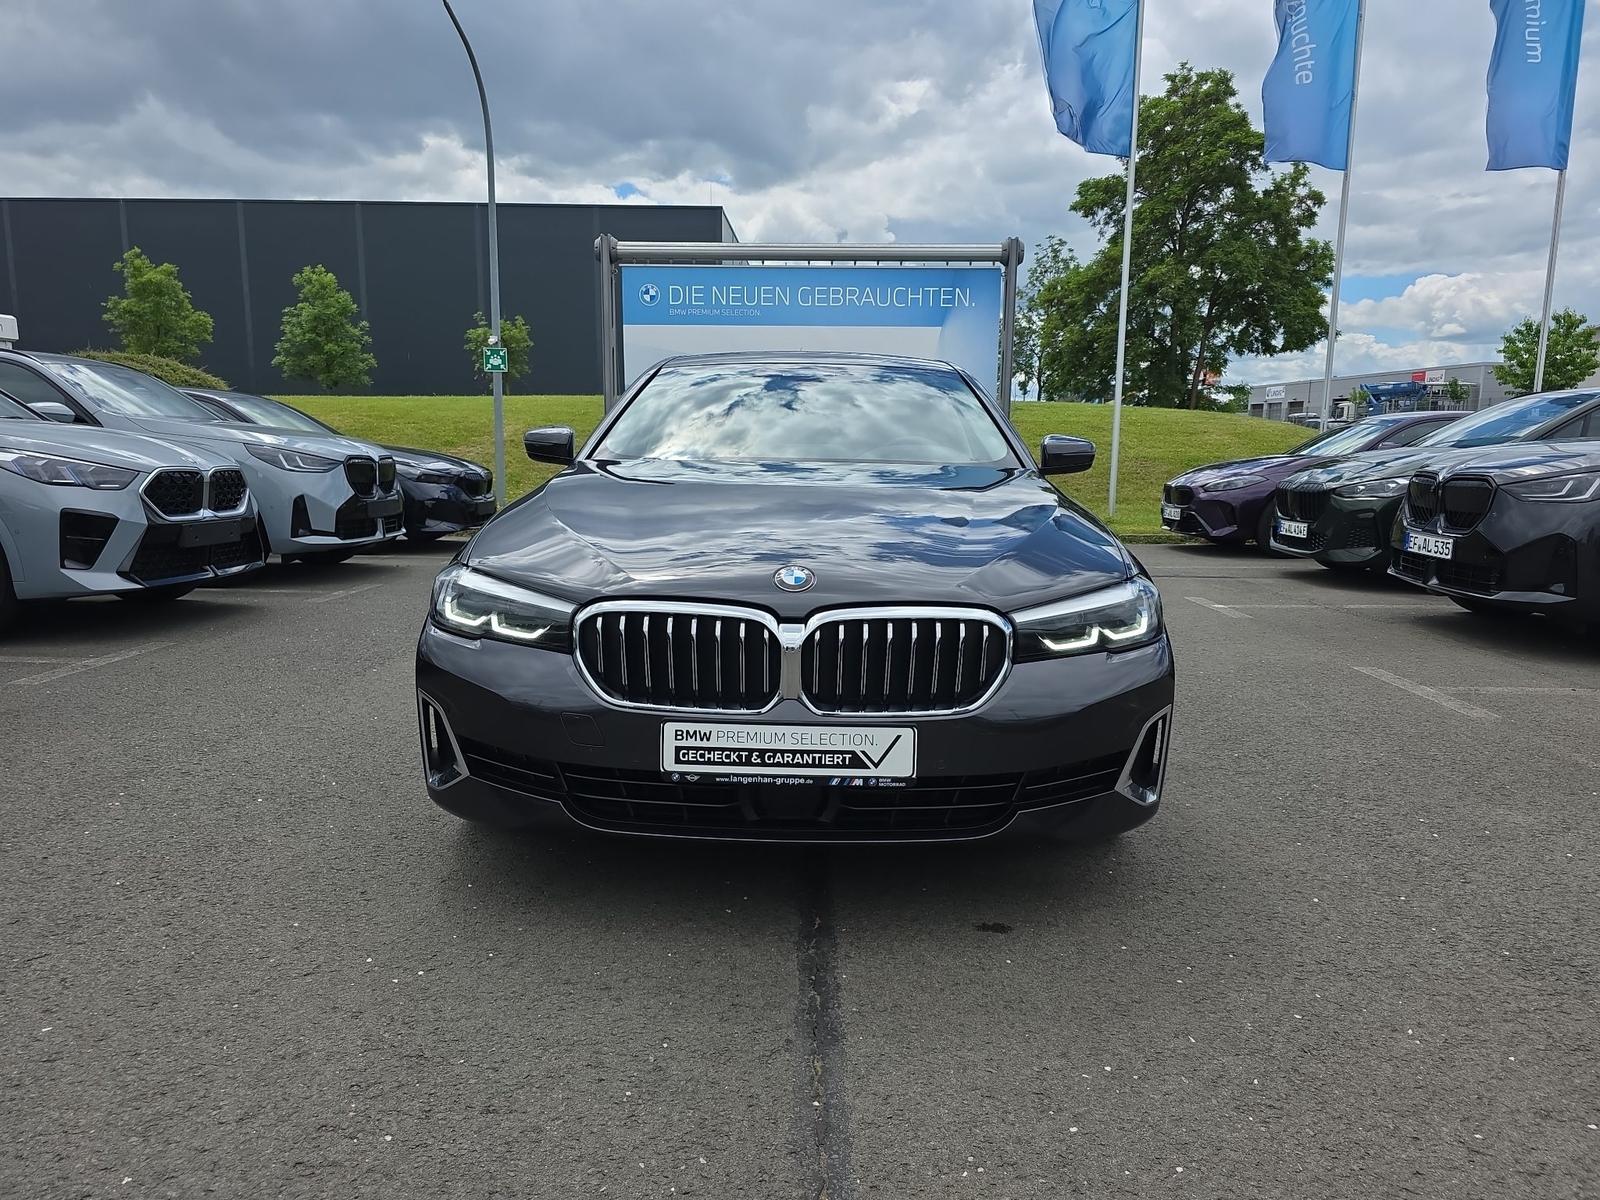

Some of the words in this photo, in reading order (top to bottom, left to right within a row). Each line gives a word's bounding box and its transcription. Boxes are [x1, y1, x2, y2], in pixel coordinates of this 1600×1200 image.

[669, 285, 705, 305] DIE
[712, 286, 790, 306] NEUEN
[797, 286, 976, 307] GEBRAUCHTEN.
[669, 308, 686, 316] BMW
[687, 308, 720, 316] PREMIUM
[1422, 538, 1432, 552] AL
[1433, 540, 1451, 556] 535
[674, 729, 712, 742] BMW
[716, 730, 786, 745] PREMIUM
[790, 732, 878, 746] SELECTION.
[679, 750, 749, 763] GECHECKT
[751, 752, 762, 763] &
[764, 752, 852, 765] GARANTIERT
[715, 774, 814, 785] www.langenhan-gruppe.de
